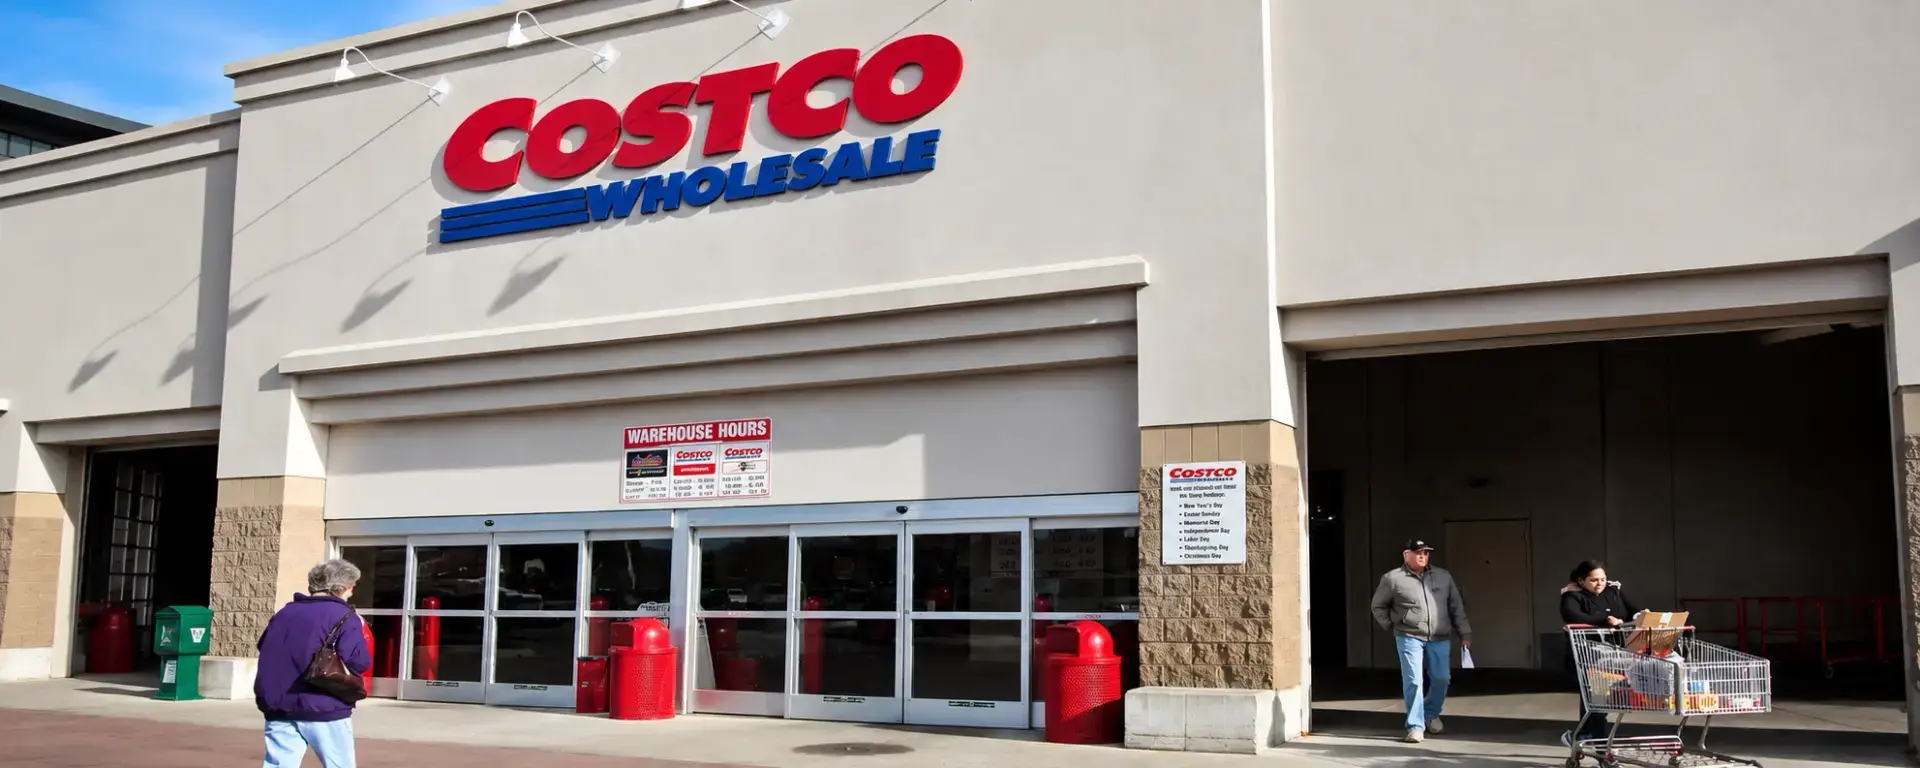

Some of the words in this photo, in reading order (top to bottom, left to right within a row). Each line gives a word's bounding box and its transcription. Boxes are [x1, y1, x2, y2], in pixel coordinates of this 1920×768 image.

[443, 33, 963, 192] COSTCO
[586, 129, 941, 222] WHOLESALE
[628, 424, 713, 444] WAREHOUSE
[718, 420, 767, 438] HOURS
[676, 451, 713, 459] COSTCO
[725, 448, 763, 457] COSTCO
[1169, 467, 1237, 478] COSTCO
